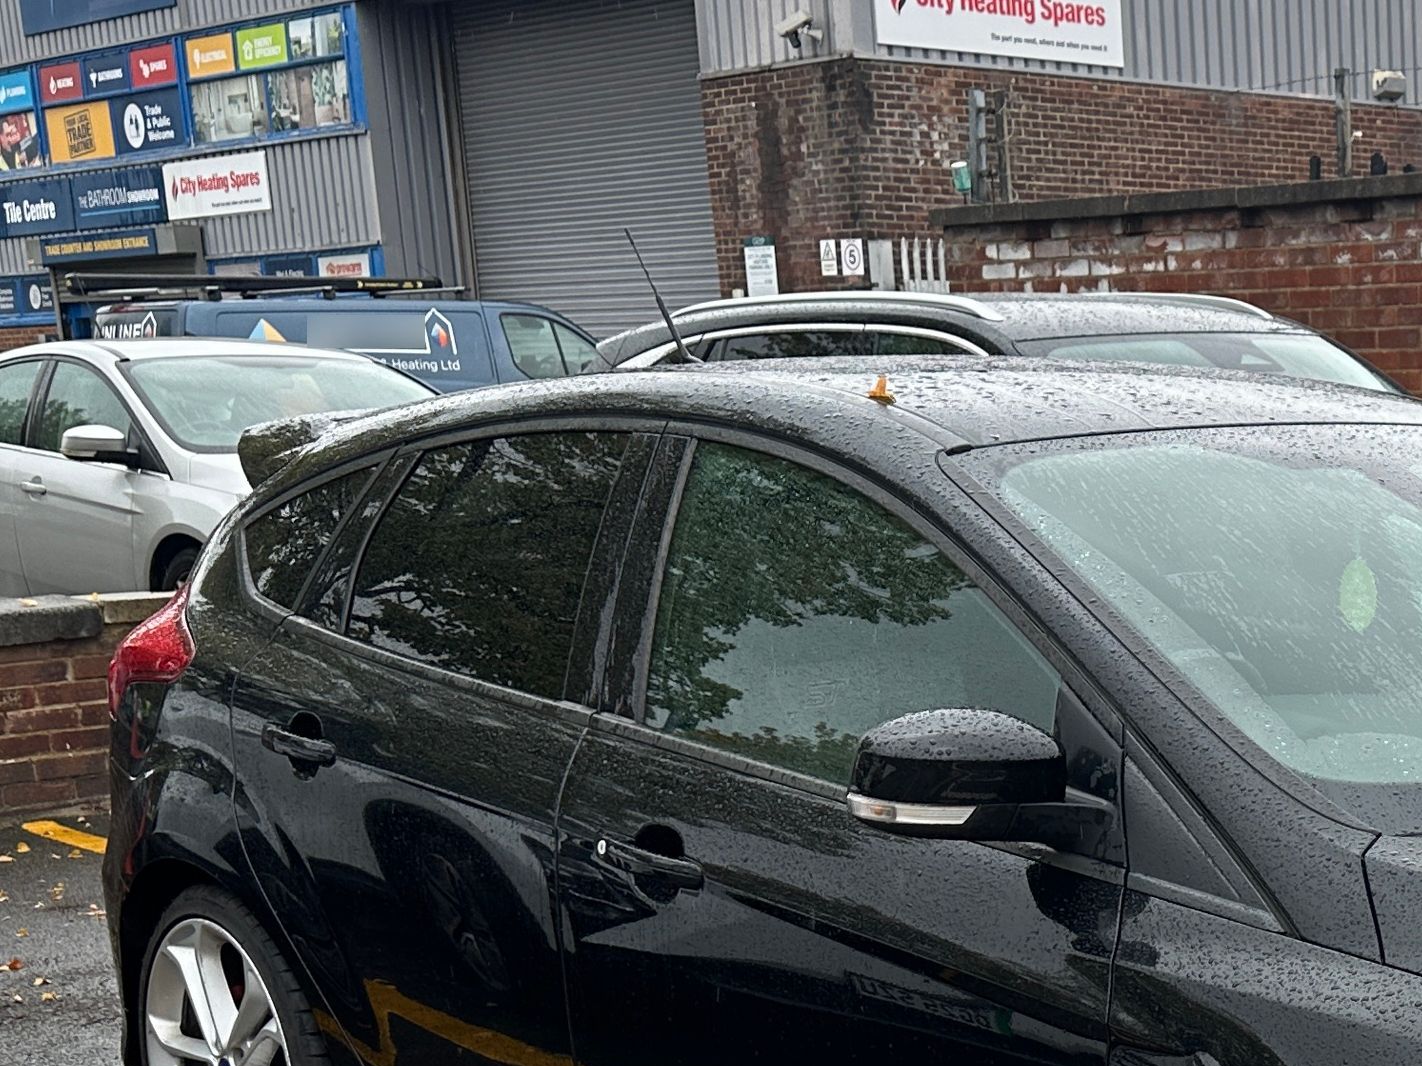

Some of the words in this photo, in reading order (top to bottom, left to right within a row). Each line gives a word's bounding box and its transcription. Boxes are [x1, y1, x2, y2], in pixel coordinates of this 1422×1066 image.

[1041, 0, 1105, 26] Spares
[144, 103, 161, 116] Trade
[152, 115, 171, 128] Public
[67, 122, 92, 141] TRADE
[148, 129, 174, 142] Welcome
[180, 177, 196, 196] City
[197, 172, 229, 193] Heating
[230, 171, 260, 191] Spares
[87, 187, 127, 208] BATHROOM
[3, 200, 22, 224] Tile
[23, 198, 56, 223] Centre
[849, 249, 856, 265] 5
[391, 358, 438, 373] Heating
[441, 359, 460, 371] Ltd
